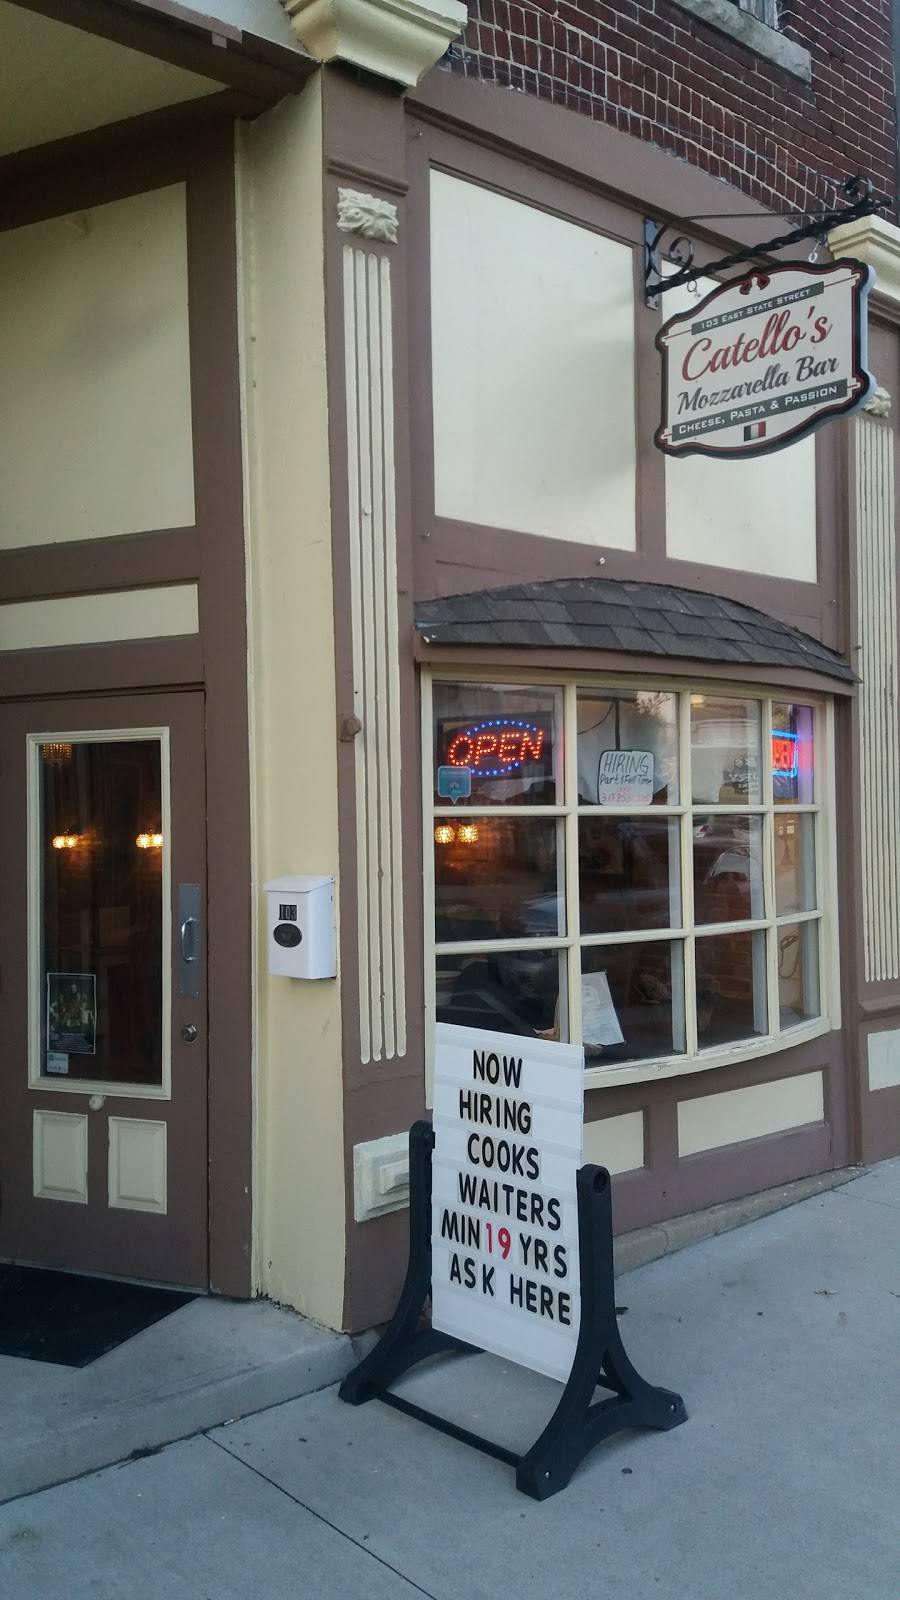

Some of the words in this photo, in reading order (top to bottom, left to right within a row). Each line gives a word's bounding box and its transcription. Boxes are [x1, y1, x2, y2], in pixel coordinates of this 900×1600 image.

[701, 319, 719, 330] 103
[721, 311, 743, 323] EAST
[747, 302, 773, 315] STATE
[776, 288, 811, 305] STREET
[681, 306, 833, 381] Catello's
[677, 363, 791, 415] Mozzarella
[795, 355, 840, 382] Bar
[679, 416, 726, 435] CHEESE,
[730, 405, 765, 421] PASTA
[770, 399, 779, 409] &
[784, 386, 838, 405] PASSION
[449, 729, 544, 766] OPEN
[604, 753, 649, 776] HIRING
[280, 905, 297, 920] 103
[473, 1049, 523, 1088] NOW
[459, 1089, 531, 1135] HIRING
[467, 1132, 539, 1180] COOKS
[458, 1172, 561, 1232] WAITERS
[441, 1209, 480, 1250] MIN
[485, 1223, 511, 1260] 19
[519, 1232, 568, 1279] YRS
[450, 1253, 495, 1297] ASK
[510, 1273, 571, 1326] HERE
